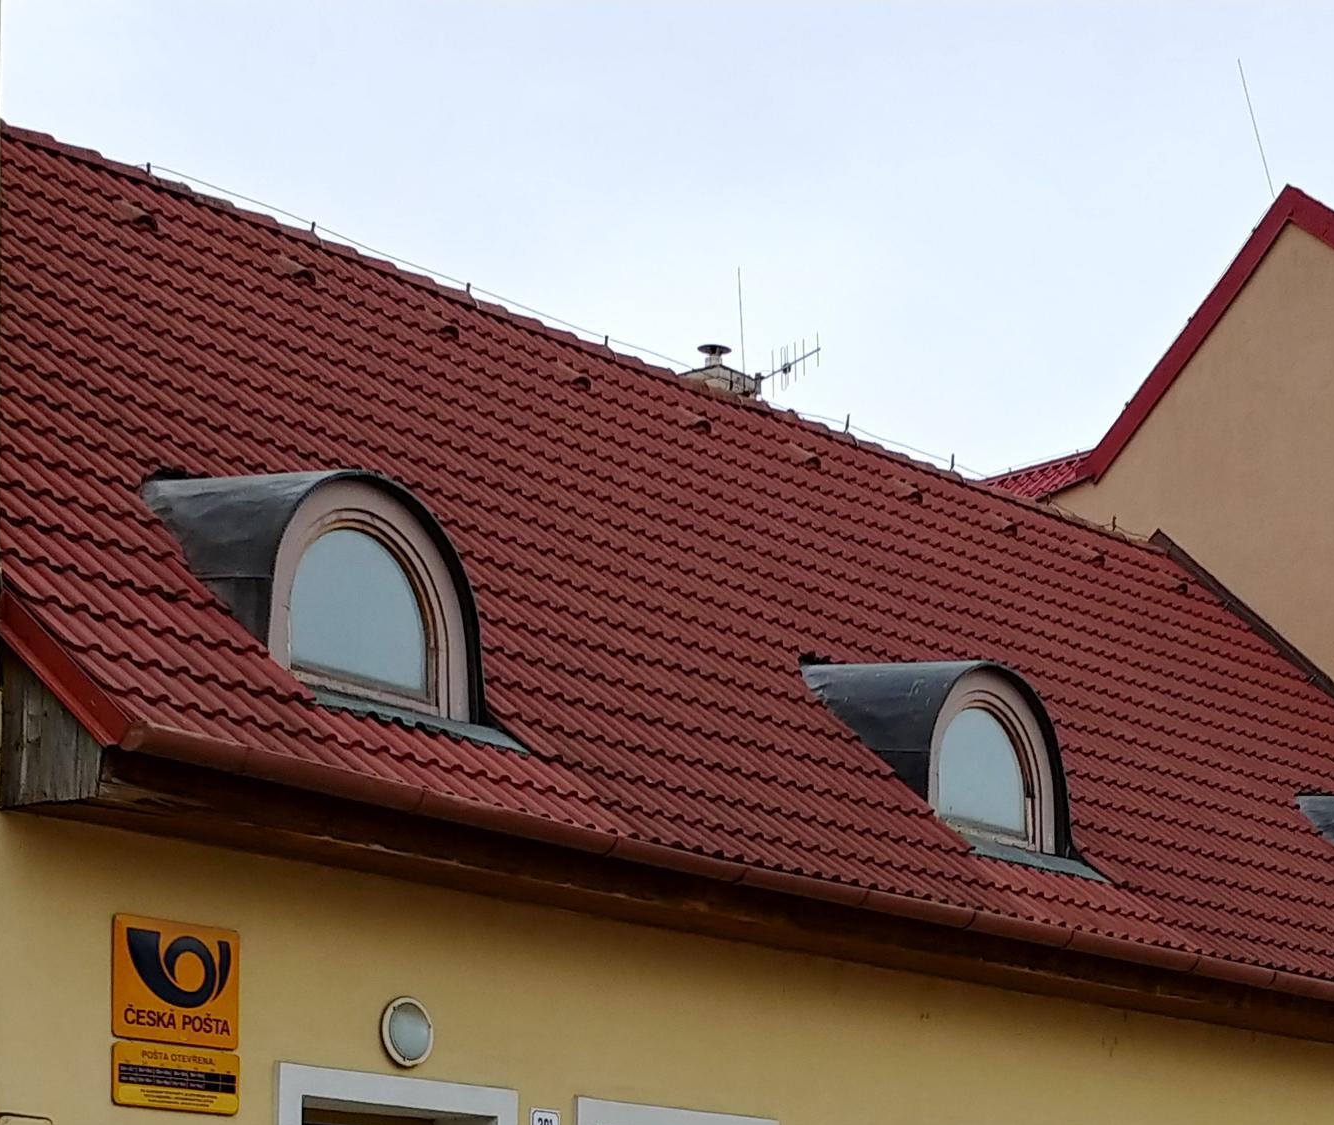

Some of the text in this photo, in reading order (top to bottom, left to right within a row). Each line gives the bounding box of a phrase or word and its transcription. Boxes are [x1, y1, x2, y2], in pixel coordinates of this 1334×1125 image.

[124, 1003, 230, 1036] ČESKÁ POŠTA
[141, 1049, 169, 1060] POŠTA
